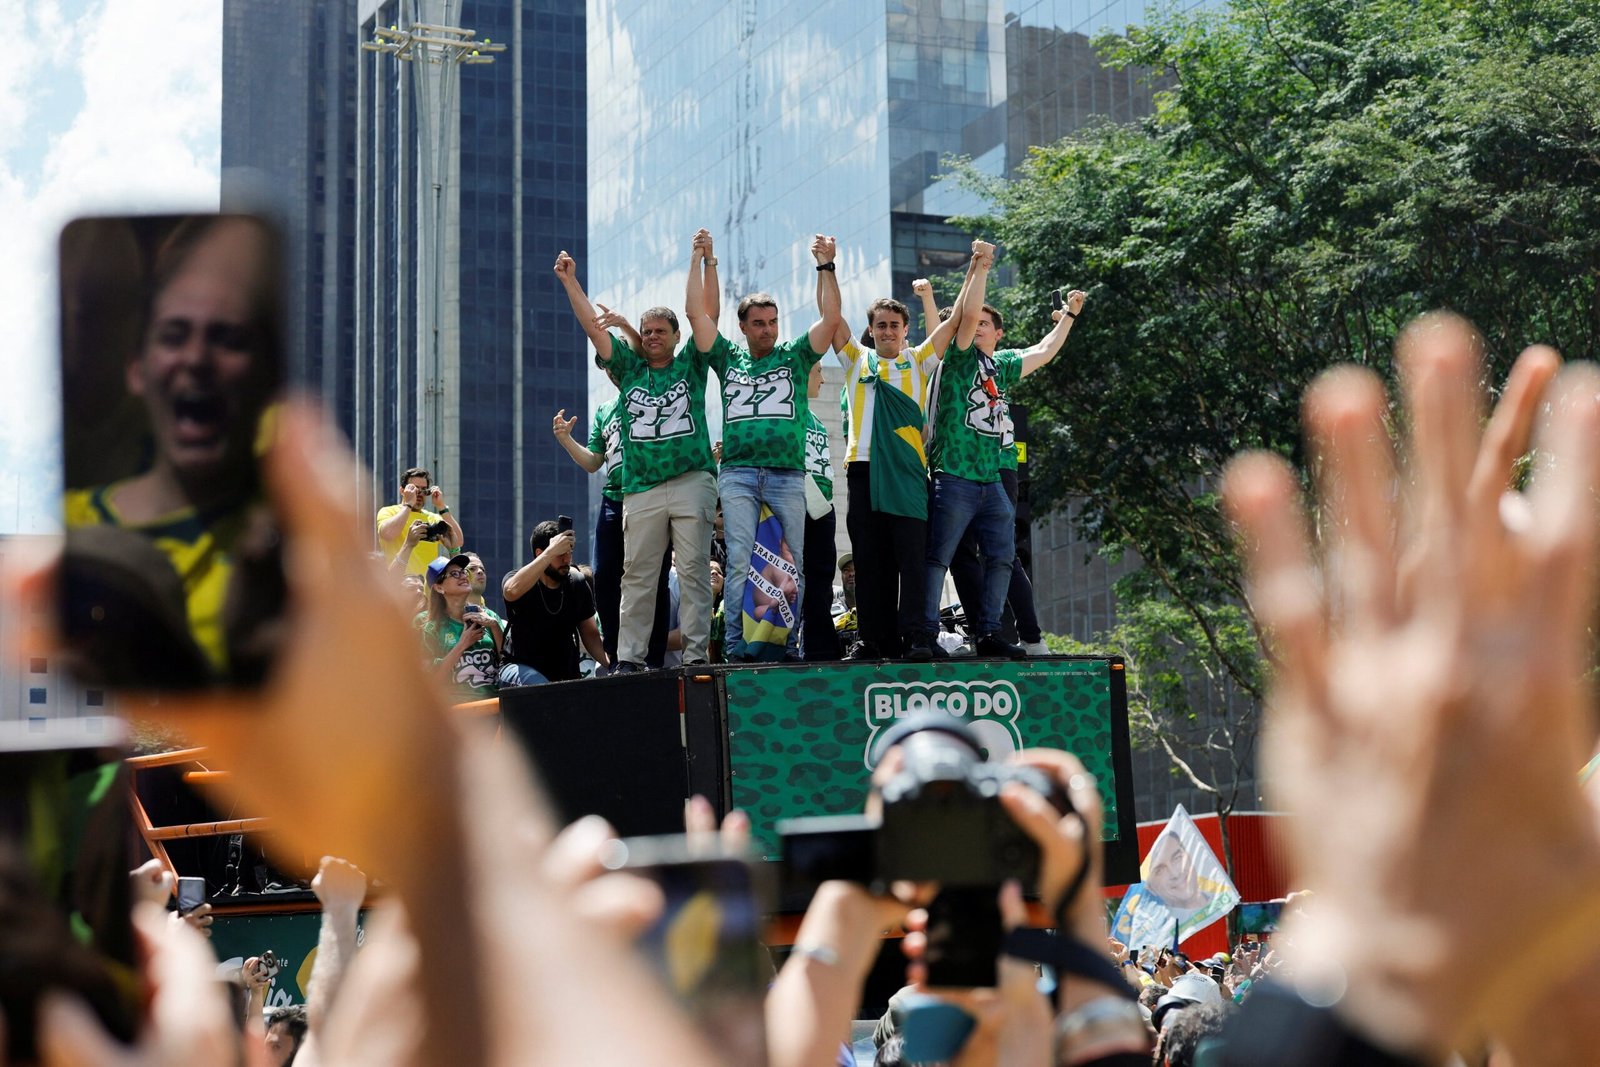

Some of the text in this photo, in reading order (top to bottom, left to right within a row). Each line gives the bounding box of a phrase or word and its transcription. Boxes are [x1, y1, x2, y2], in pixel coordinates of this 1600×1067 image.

[668, 383, 686, 401] DO
[725, 378, 791, 419] 22
[629, 394, 691, 437] 22
[753, 544, 797, 577] BRASIL SEM
[749, 569, 765, 589] ASIL
[875, 691, 1013, 719] BLOCO DO
